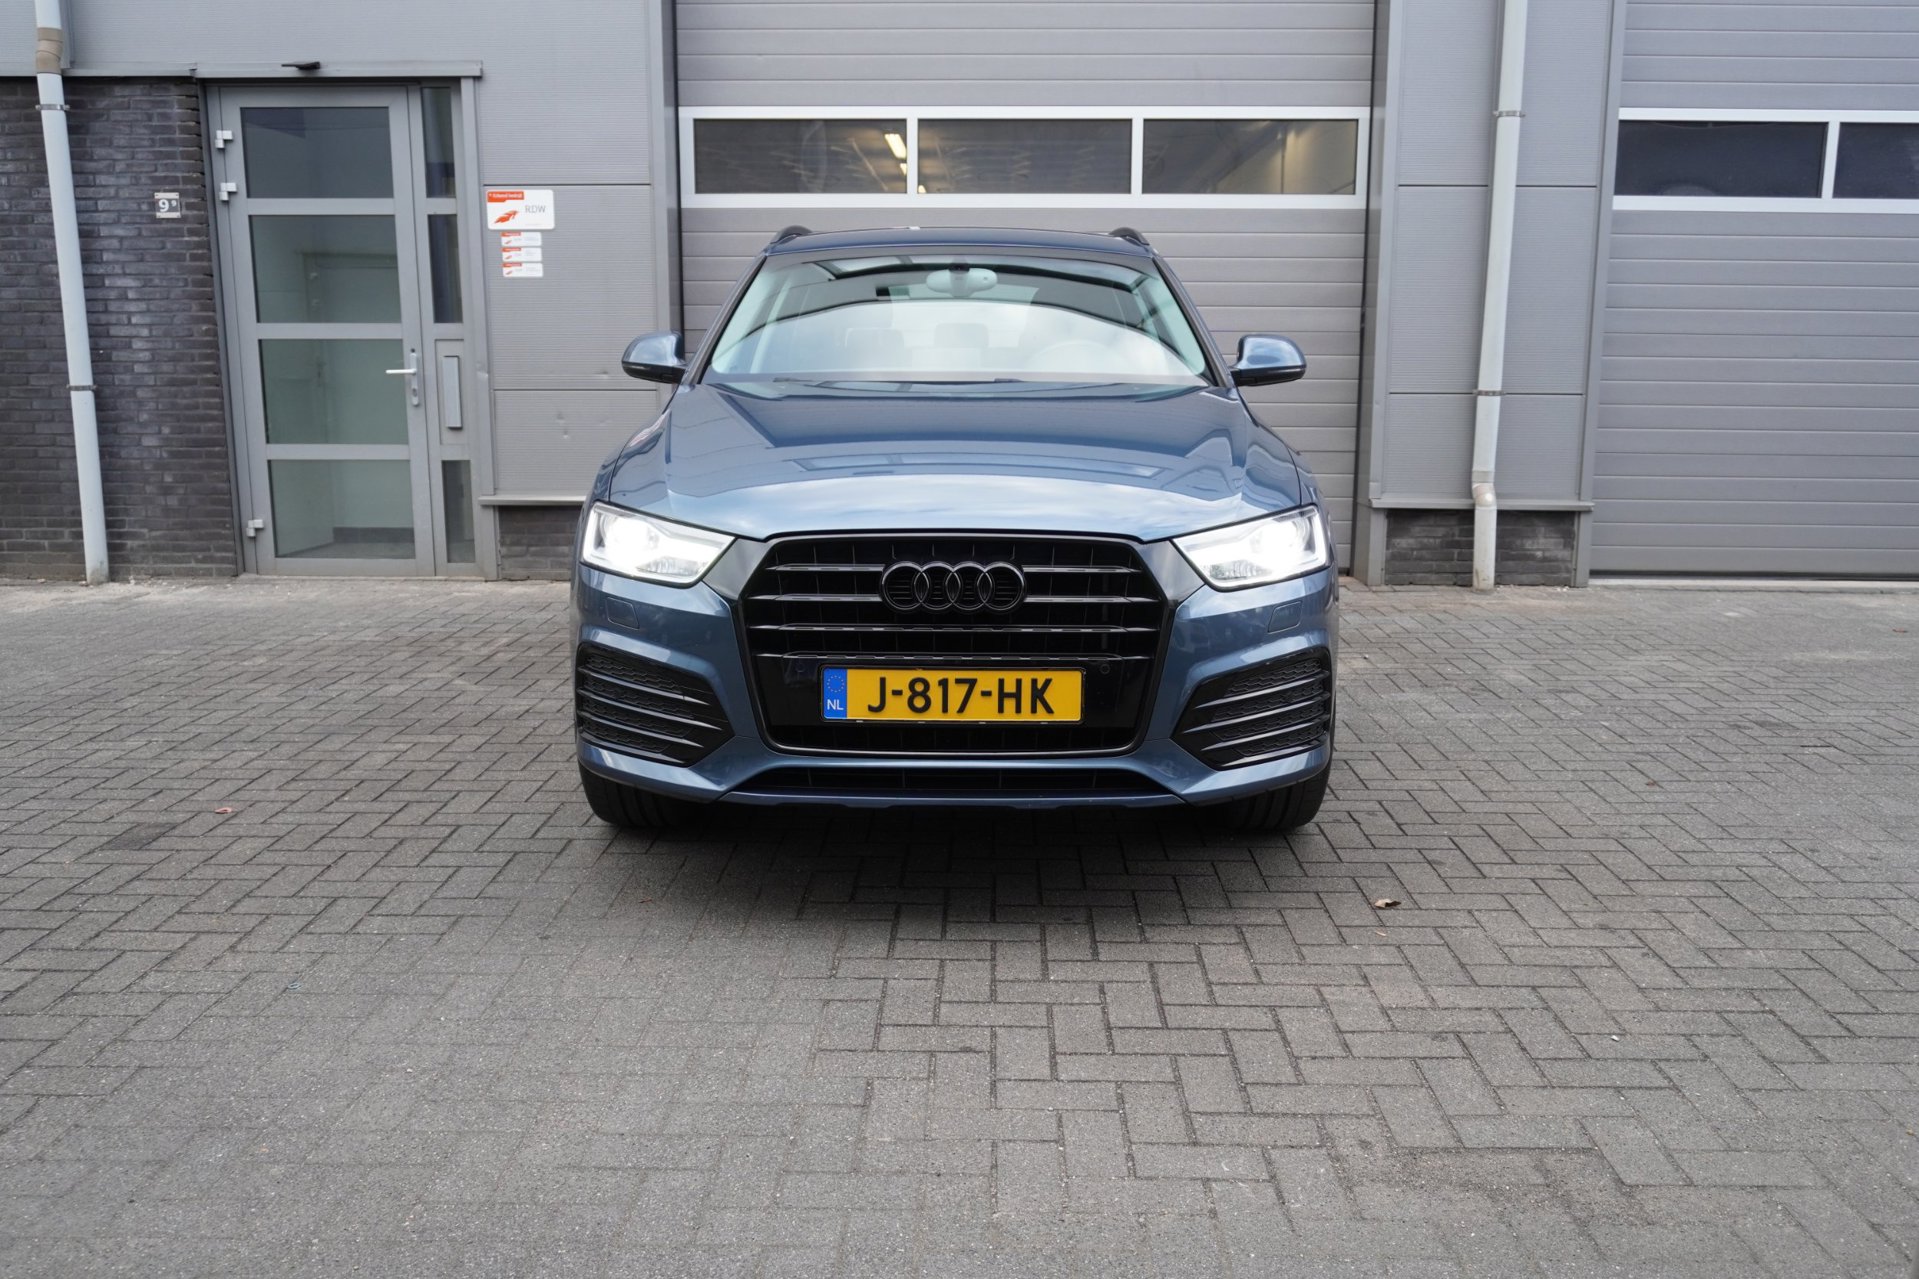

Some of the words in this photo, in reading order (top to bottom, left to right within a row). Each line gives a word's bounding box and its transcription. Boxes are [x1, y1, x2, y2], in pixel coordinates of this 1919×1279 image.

[525, 205, 546, 213] RDW
[827, 699, 844, 710] NL
[867, 677, 1054, 714] J-817-HK
